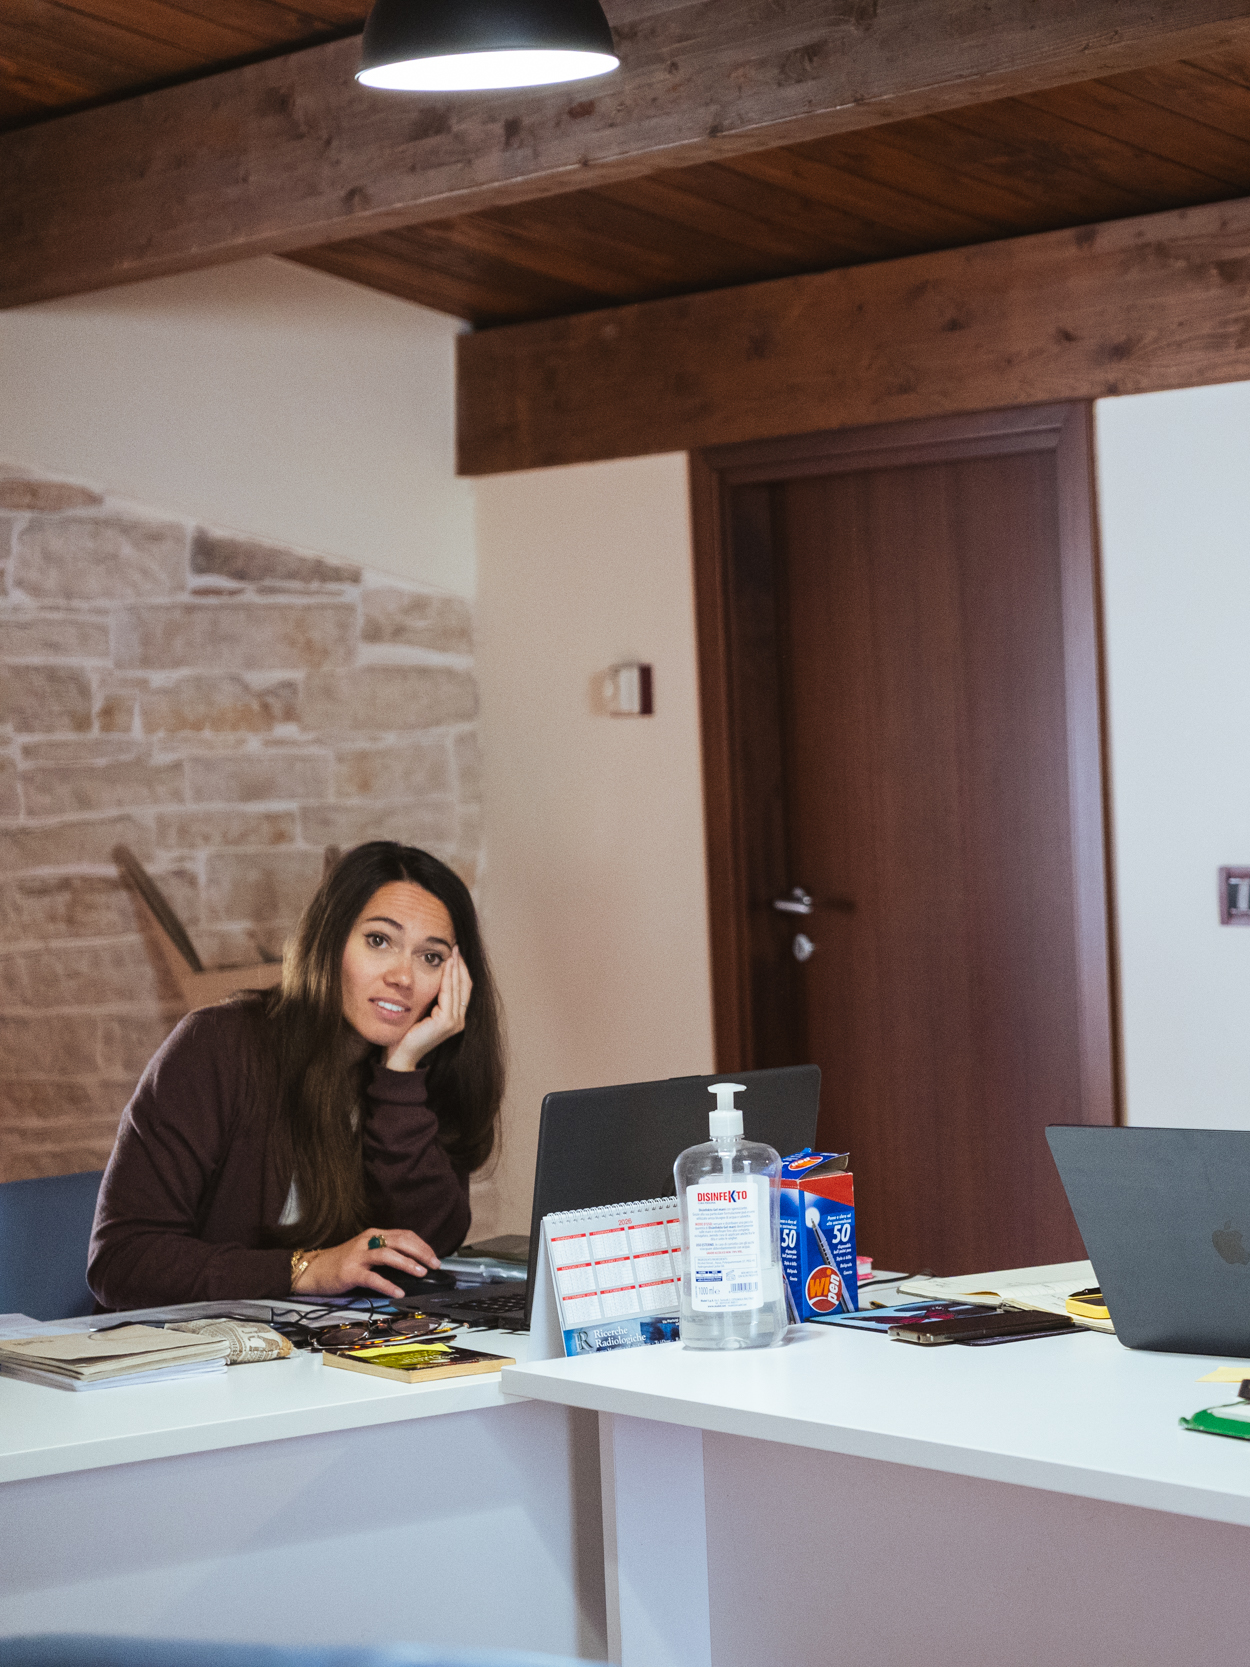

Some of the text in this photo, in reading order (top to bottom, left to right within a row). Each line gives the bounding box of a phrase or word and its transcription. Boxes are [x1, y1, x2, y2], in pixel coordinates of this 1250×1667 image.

[697, 1190, 747, 1202] DISINFEKTO
[618, 1218, 632, 1226] 2026
[781, 1229, 796, 1248] 50
[832, 1224, 850, 1243] 50
[827, 1274, 840, 1304] pen
[594, 1327, 628, 1338] Ricerche
[595, 1333, 646, 1348] Radiologiche
